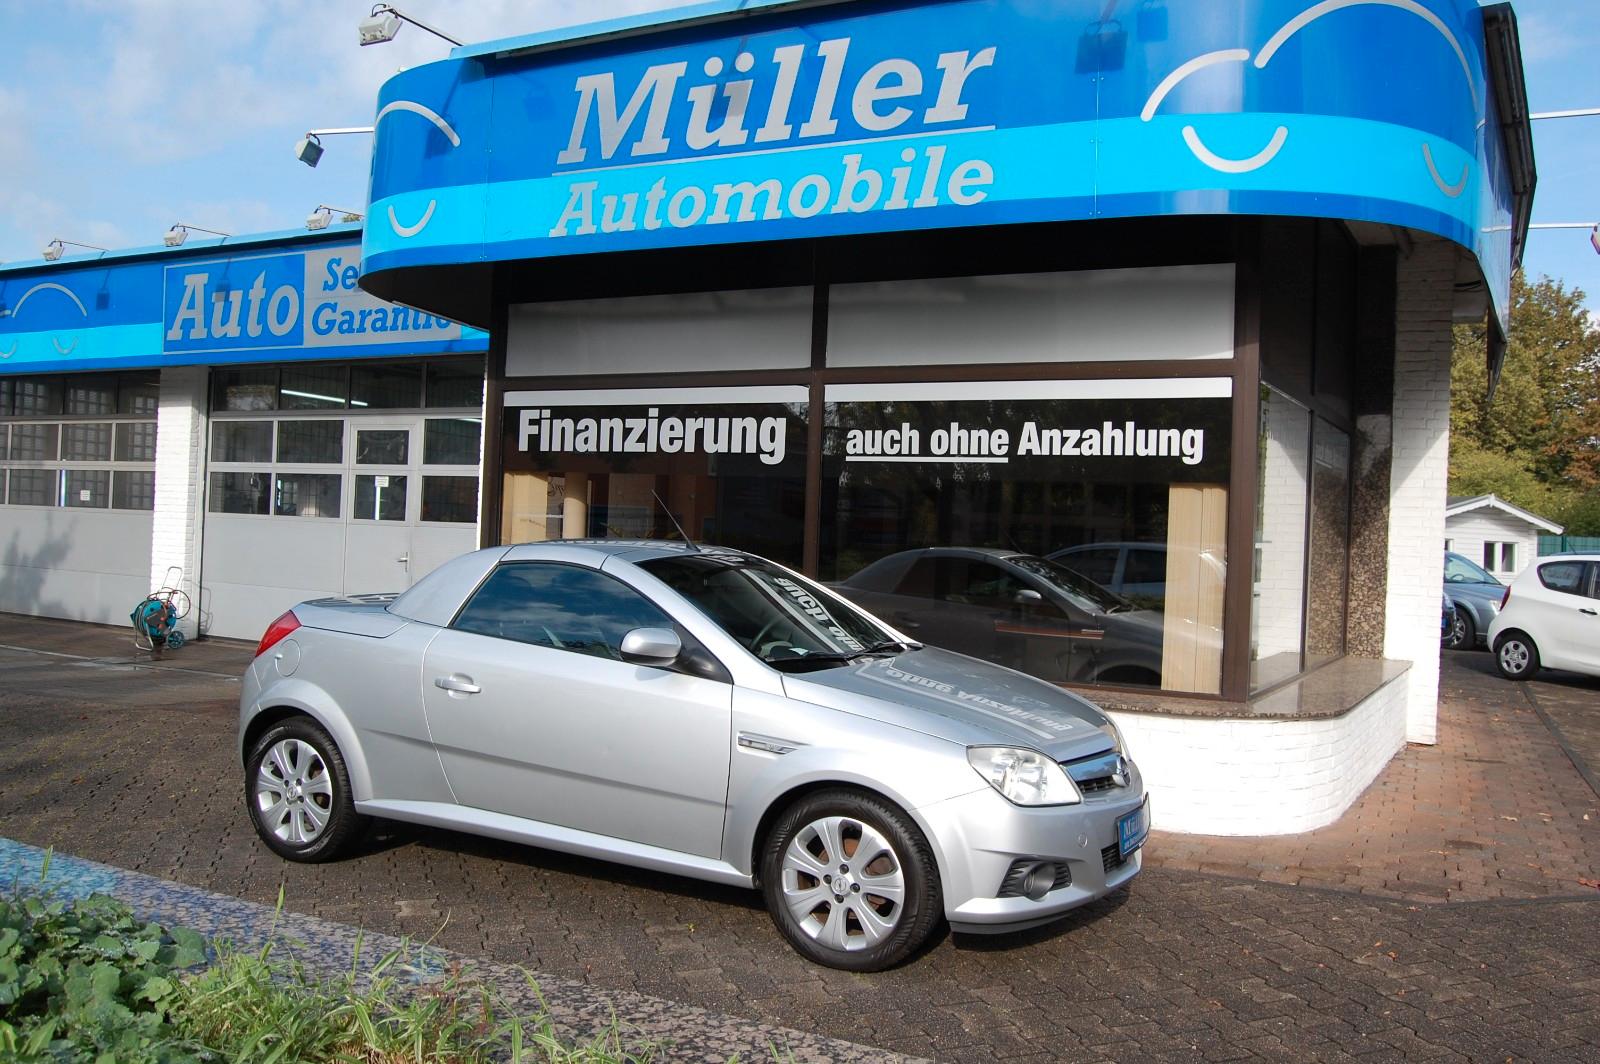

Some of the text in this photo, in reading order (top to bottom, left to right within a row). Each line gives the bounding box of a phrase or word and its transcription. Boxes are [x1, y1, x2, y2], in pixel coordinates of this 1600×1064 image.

[557, 37, 997, 165] Müller
[549, 145, 995, 238] Automobile
[166, 269, 300, 341] Auto
[518, 407, 787, 466] Finanzierung
[845, 421, 1204, 466] auch ohne Anzahlung
